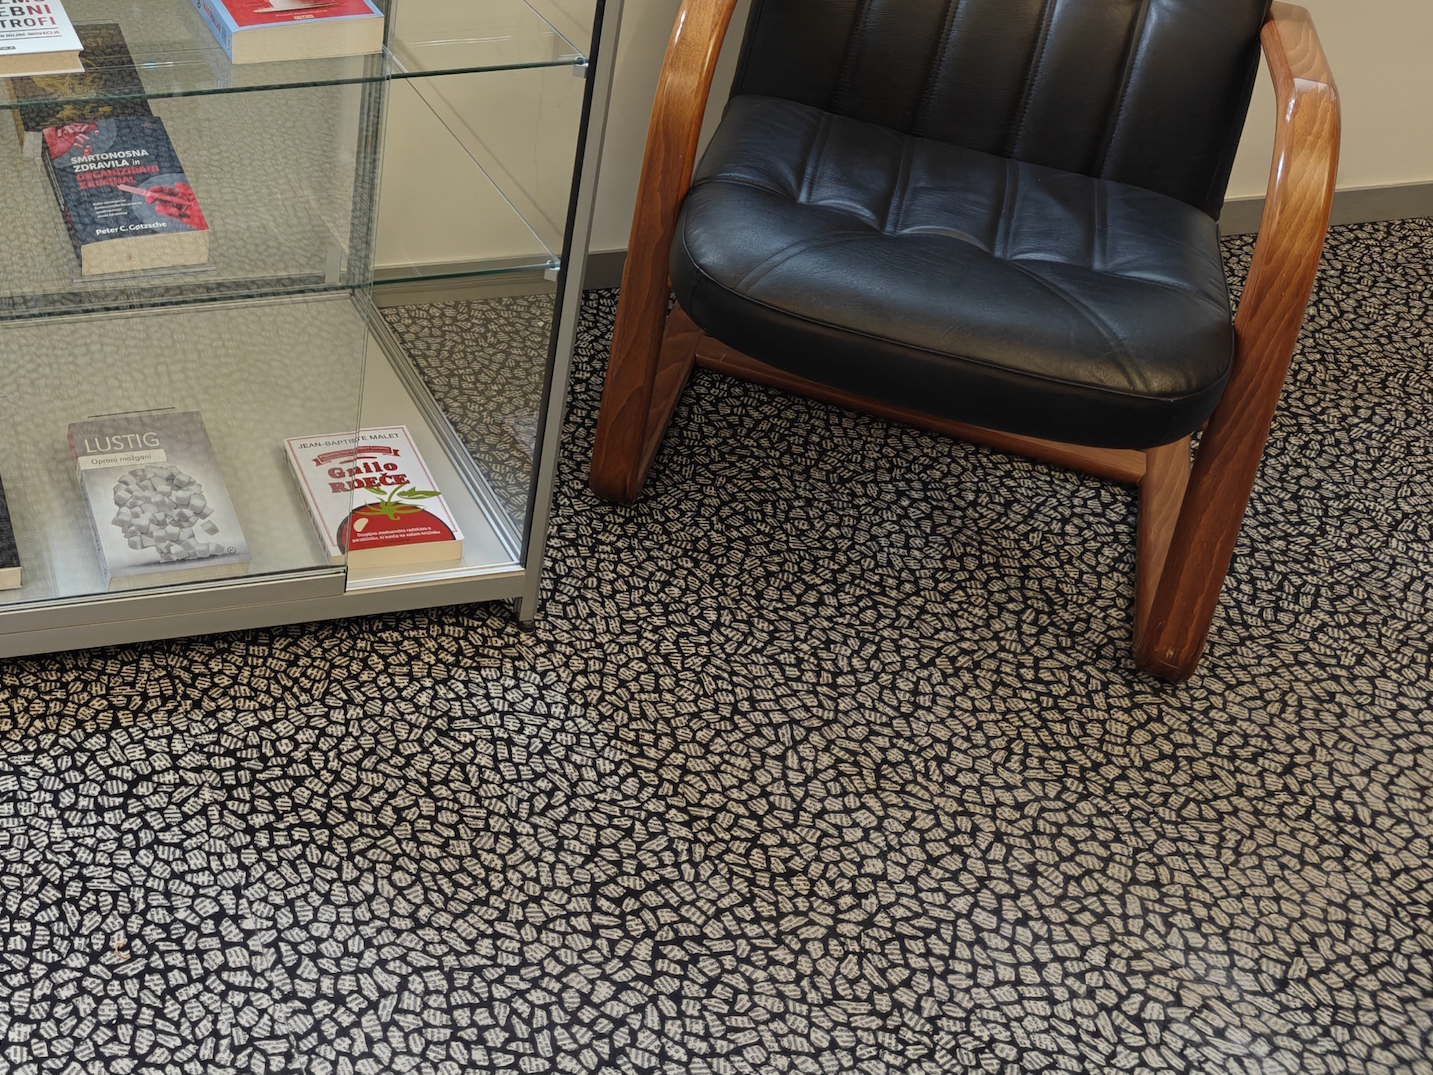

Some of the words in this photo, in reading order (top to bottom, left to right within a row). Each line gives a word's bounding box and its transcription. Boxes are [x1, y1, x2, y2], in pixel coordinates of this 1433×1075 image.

[70, 149, 149, 165] SMRTONOSNA
[73, 160, 130, 173] ZDRAVILA
[131, 158, 141, 166] in
[76, 164, 160, 181] ORGANIZIRANI
[95, 227, 118, 236] Peter
[84, 432, 160, 453] LUSTIG
[119, 453, 152, 462] možgani
[327, 461, 398, 479] Gnilo
[328, 472, 410, 493] RDEČE
